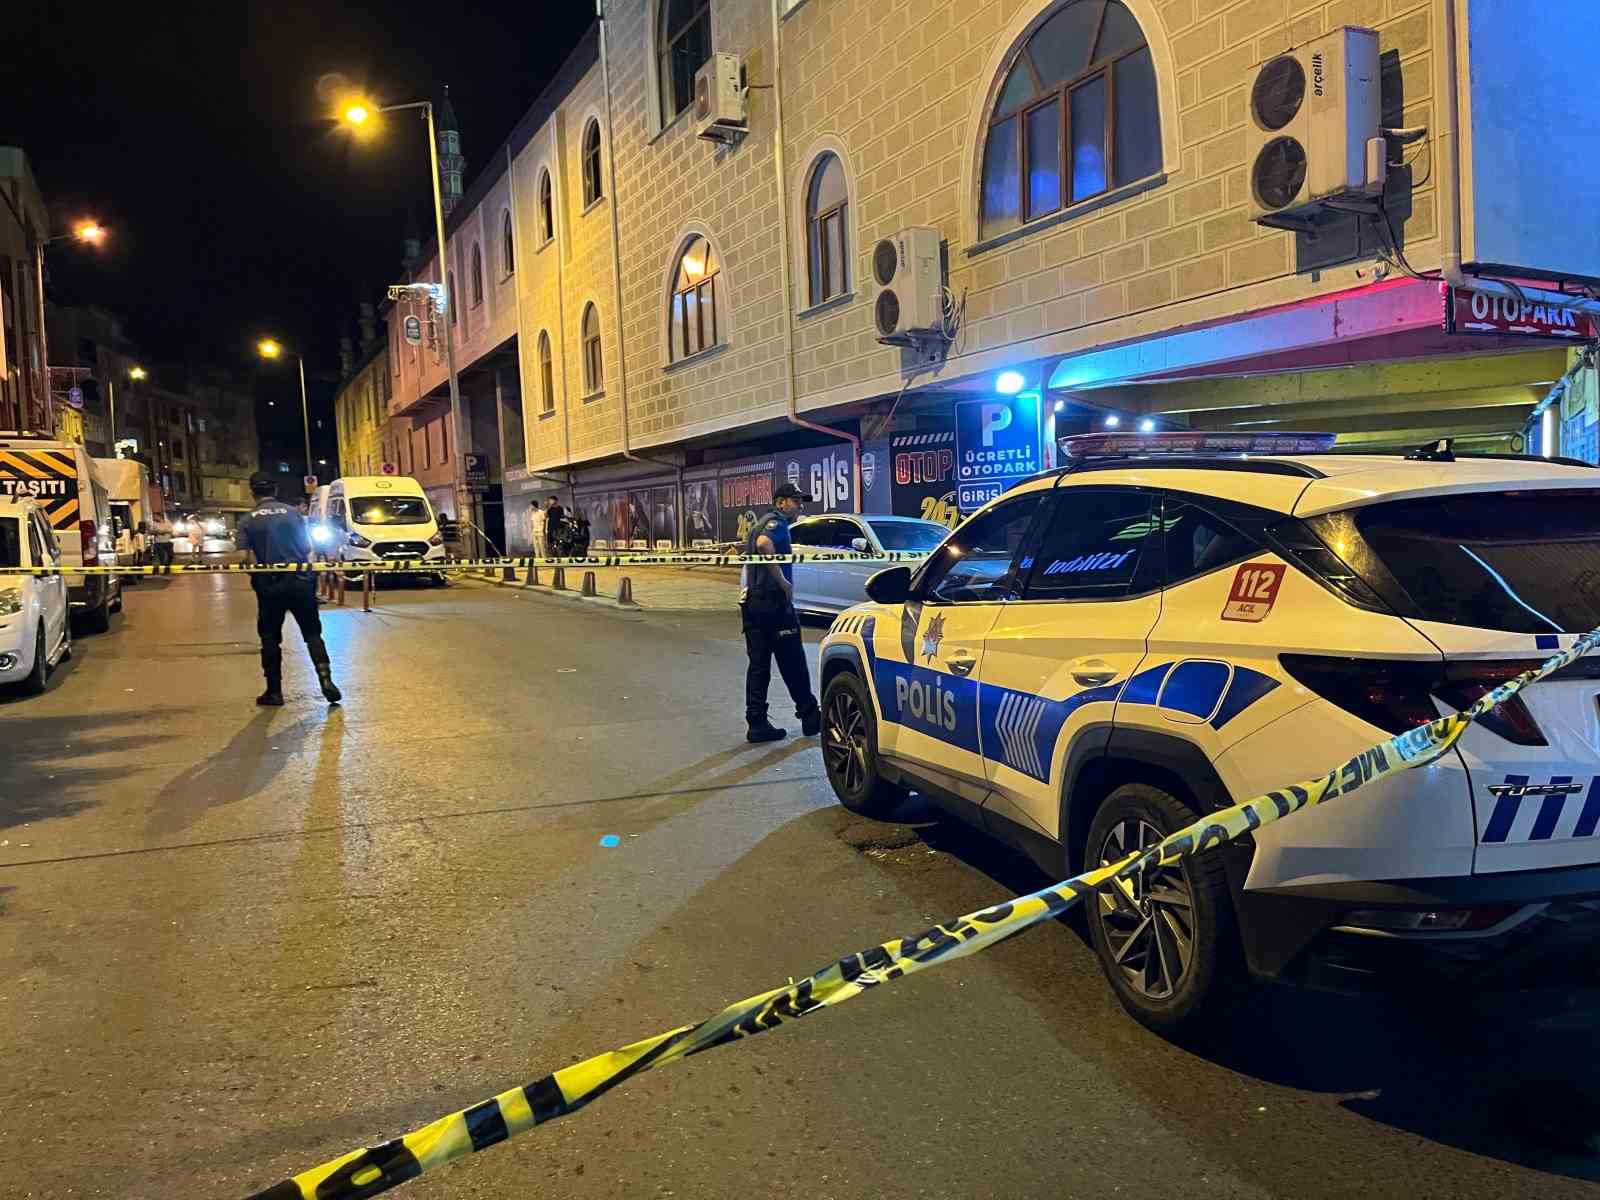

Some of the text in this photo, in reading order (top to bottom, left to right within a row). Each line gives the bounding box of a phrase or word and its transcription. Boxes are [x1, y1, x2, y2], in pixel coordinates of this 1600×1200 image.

[1311, 51, 1324, 97] arçelik
[981, 404, 1012, 447] P
[810, 452, 849, 513] GNS
[895, 448, 957, 485] OTOP
[961, 460, 1036, 477] OTOPARK
[3, 480, 66, 498] TAŞITI
[1238, 569, 1276, 599] 112
[895, 674, 957, 732] POLİS
